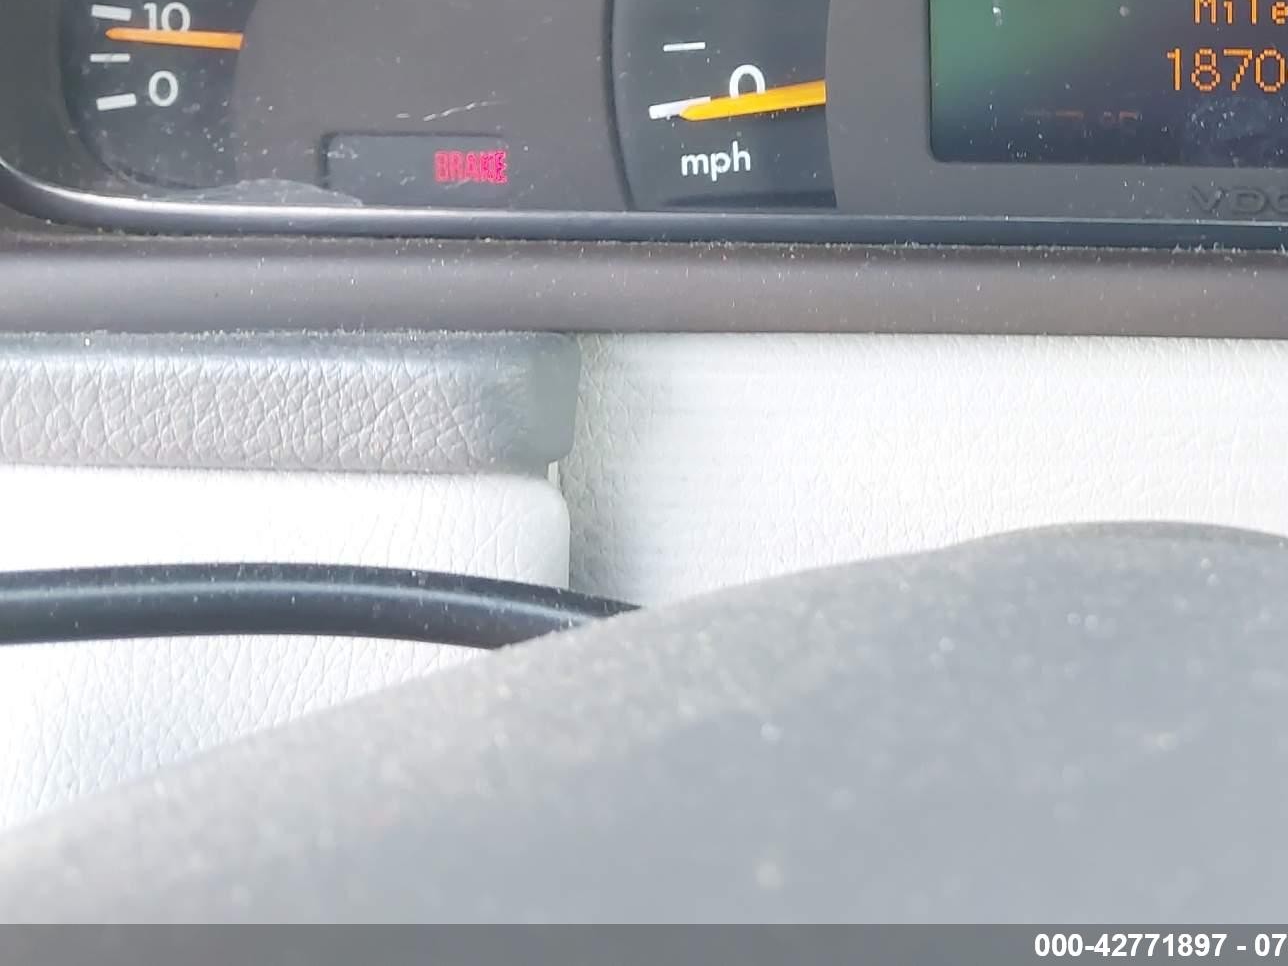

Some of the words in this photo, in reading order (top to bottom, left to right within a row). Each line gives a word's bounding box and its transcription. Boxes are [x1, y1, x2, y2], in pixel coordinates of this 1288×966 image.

[143, 2, 191, 32] 10
[149, 70, 178, 106] 0
[434, 150, 508, 183] BRAKE
[681, 140, 751, 181] mph
